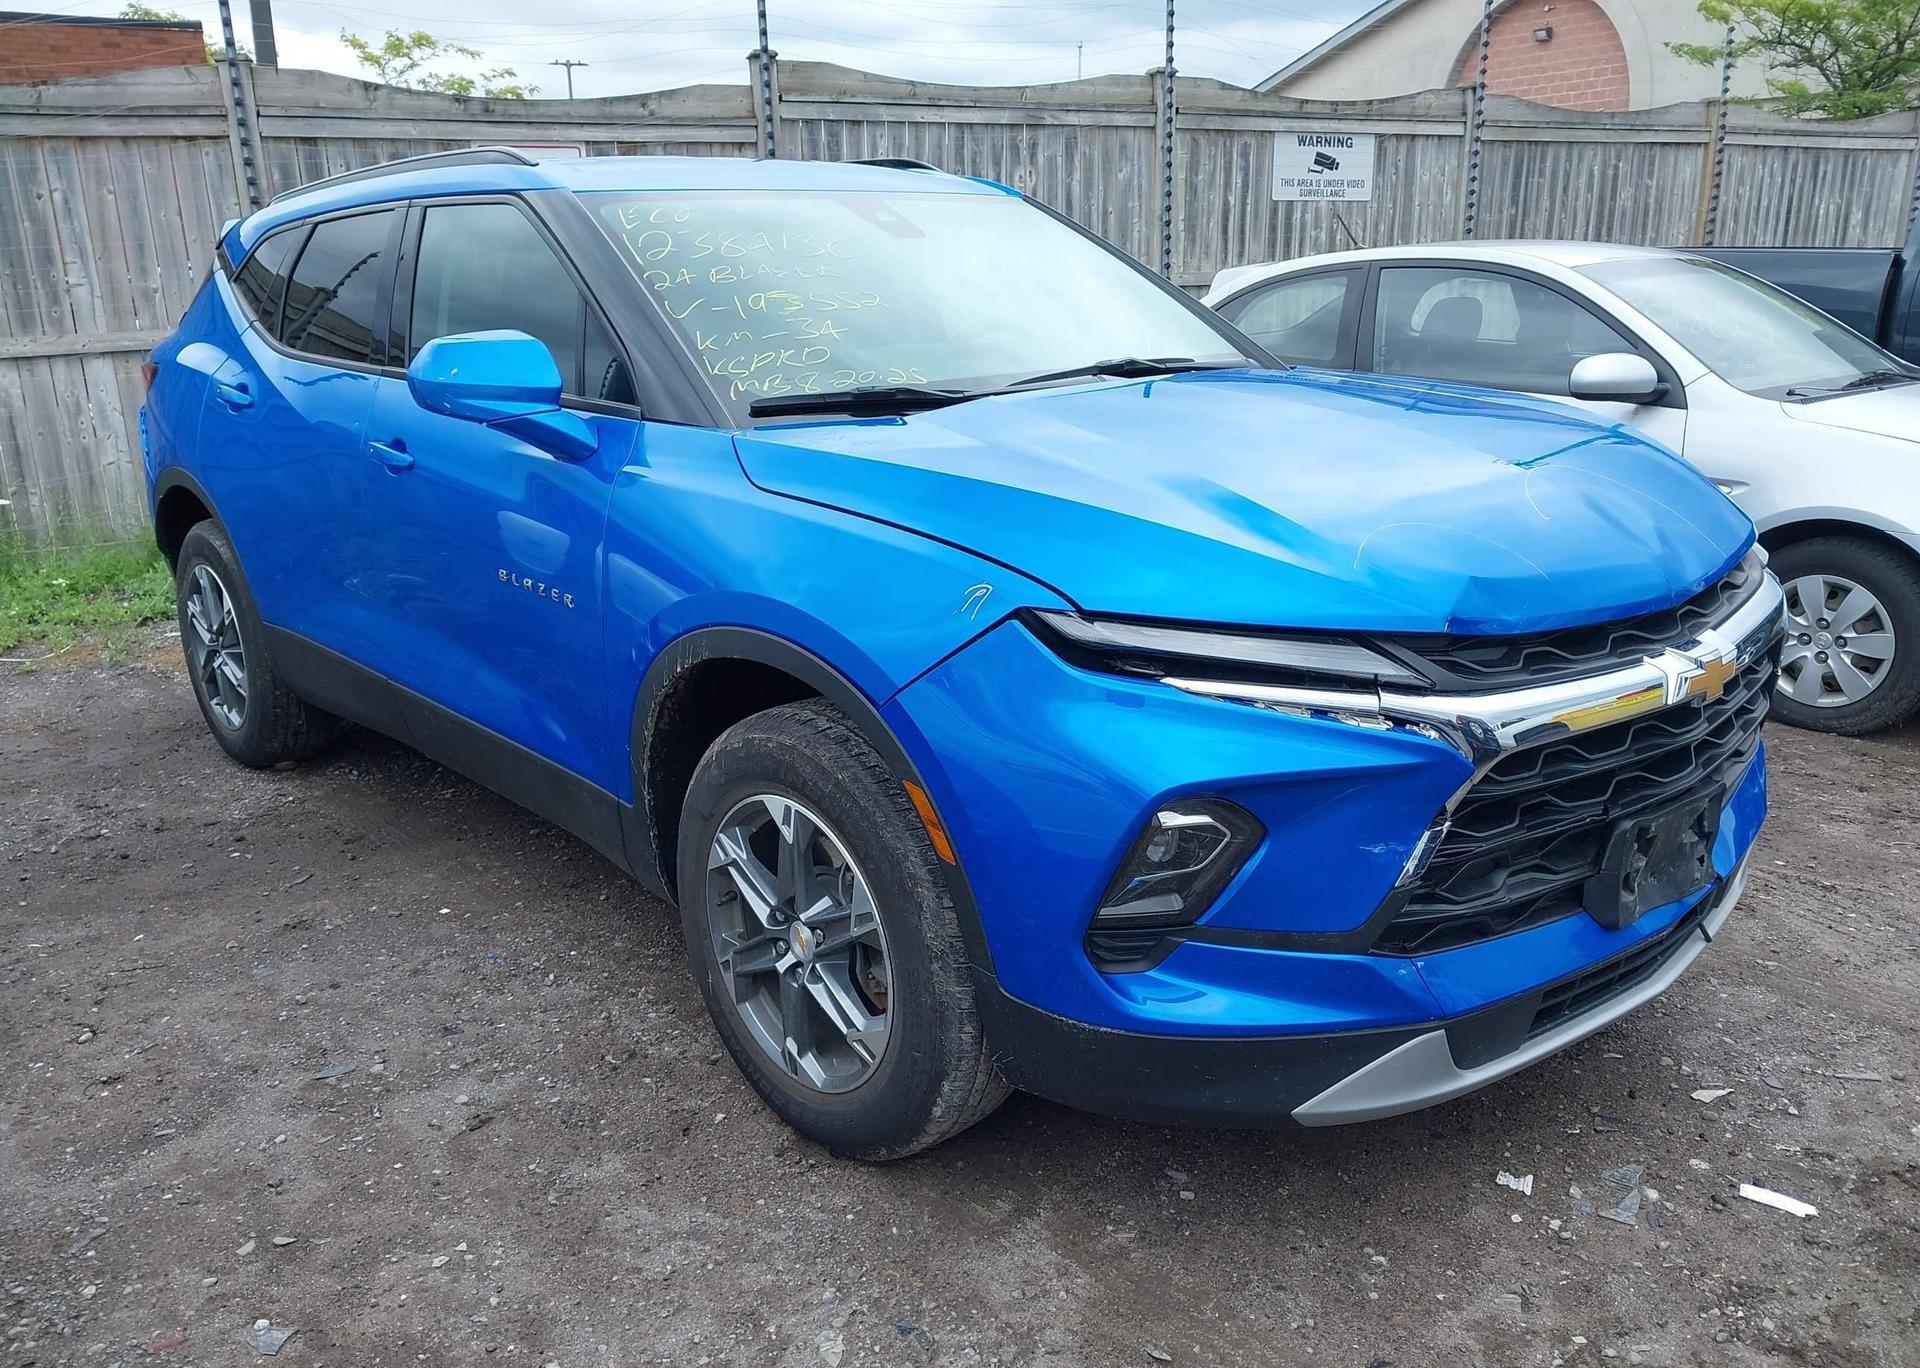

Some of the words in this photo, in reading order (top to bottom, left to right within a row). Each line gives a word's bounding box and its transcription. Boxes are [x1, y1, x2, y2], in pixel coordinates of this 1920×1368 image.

[1297, 134, 1354, 149] WARNING
[1280, 178, 1295, 188] THIS
[1296, 178, 1314, 188] AREA
[1315, 178, 1322, 188] IS
[1323, 179, 1345, 189] UNDER
[1346, 179, 1365, 189] VIDEO
[1299, 188, 1347, 198] SURVEILLANCE
[498, 568, 575, 609] BLAZER
